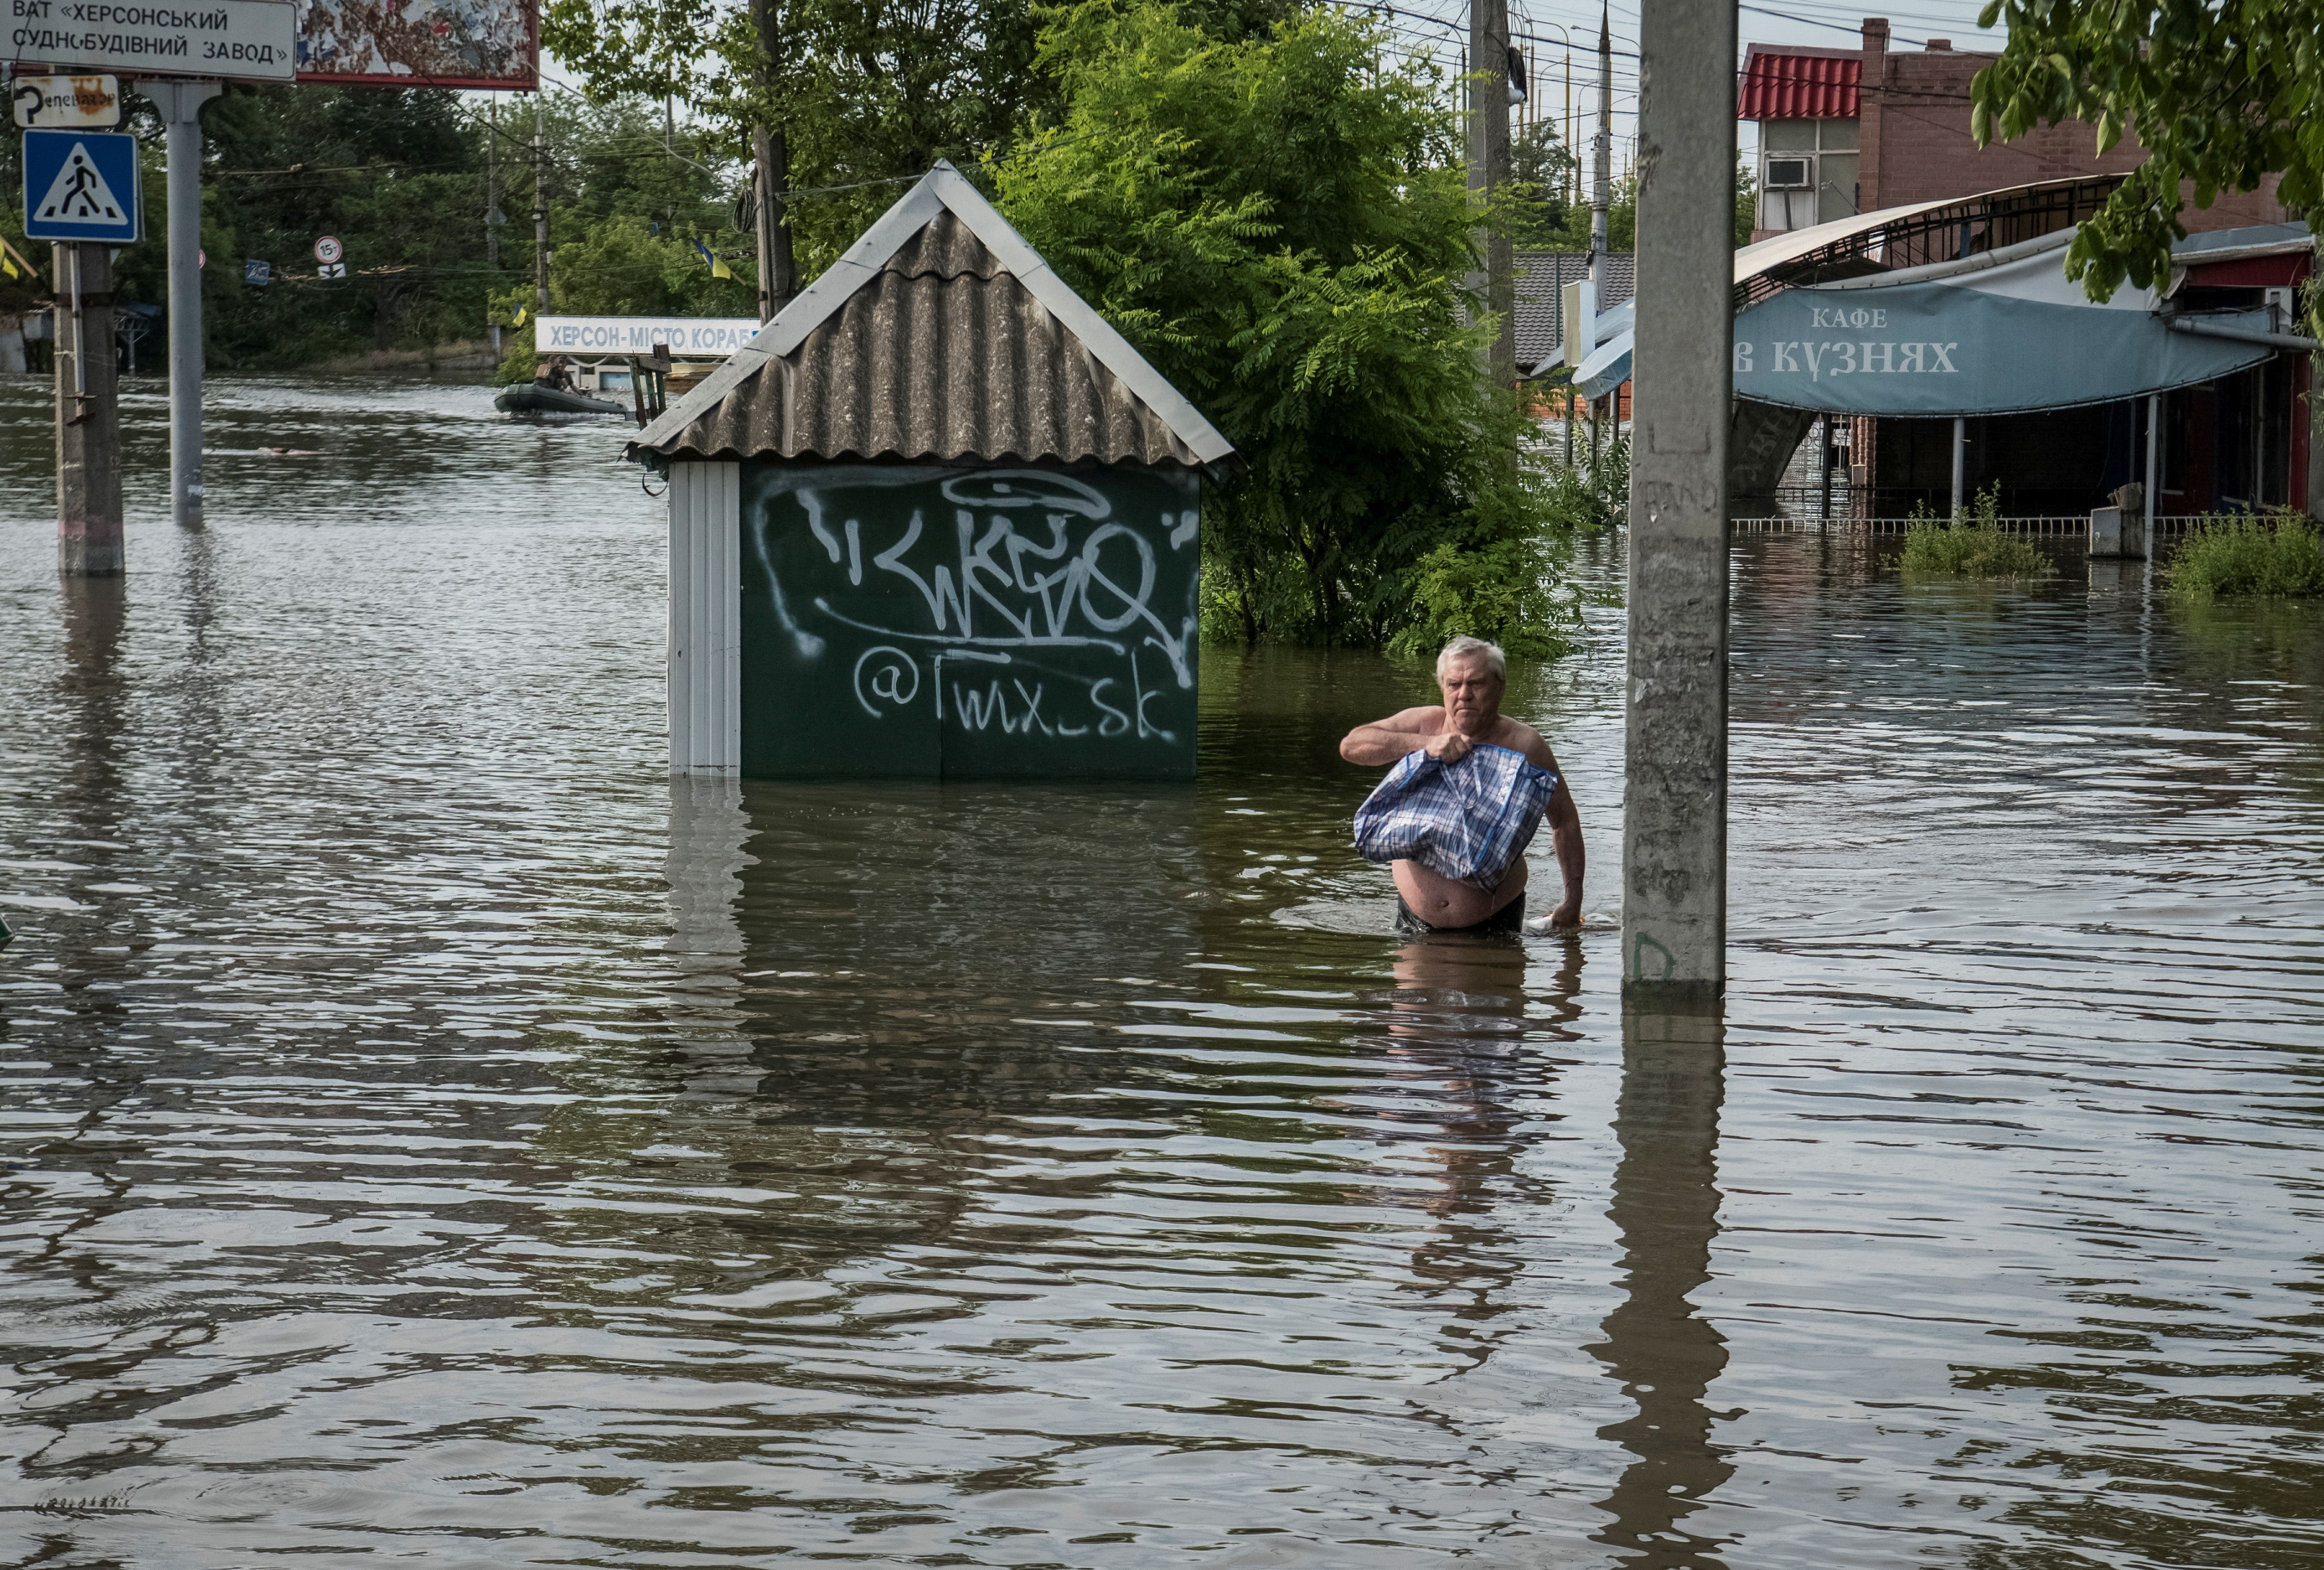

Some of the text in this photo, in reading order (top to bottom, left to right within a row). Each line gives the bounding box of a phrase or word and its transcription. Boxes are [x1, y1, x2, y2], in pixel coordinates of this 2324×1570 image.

[13, 0, 227, 30] ВАТ «ХЕРСОНСЬКИЙ
[203, 41, 287, 64] ЗАВОД»
[1811, 308, 1887, 328] КАФЕ
[1771, 342, 1958, 382] КУЗНЯХ
